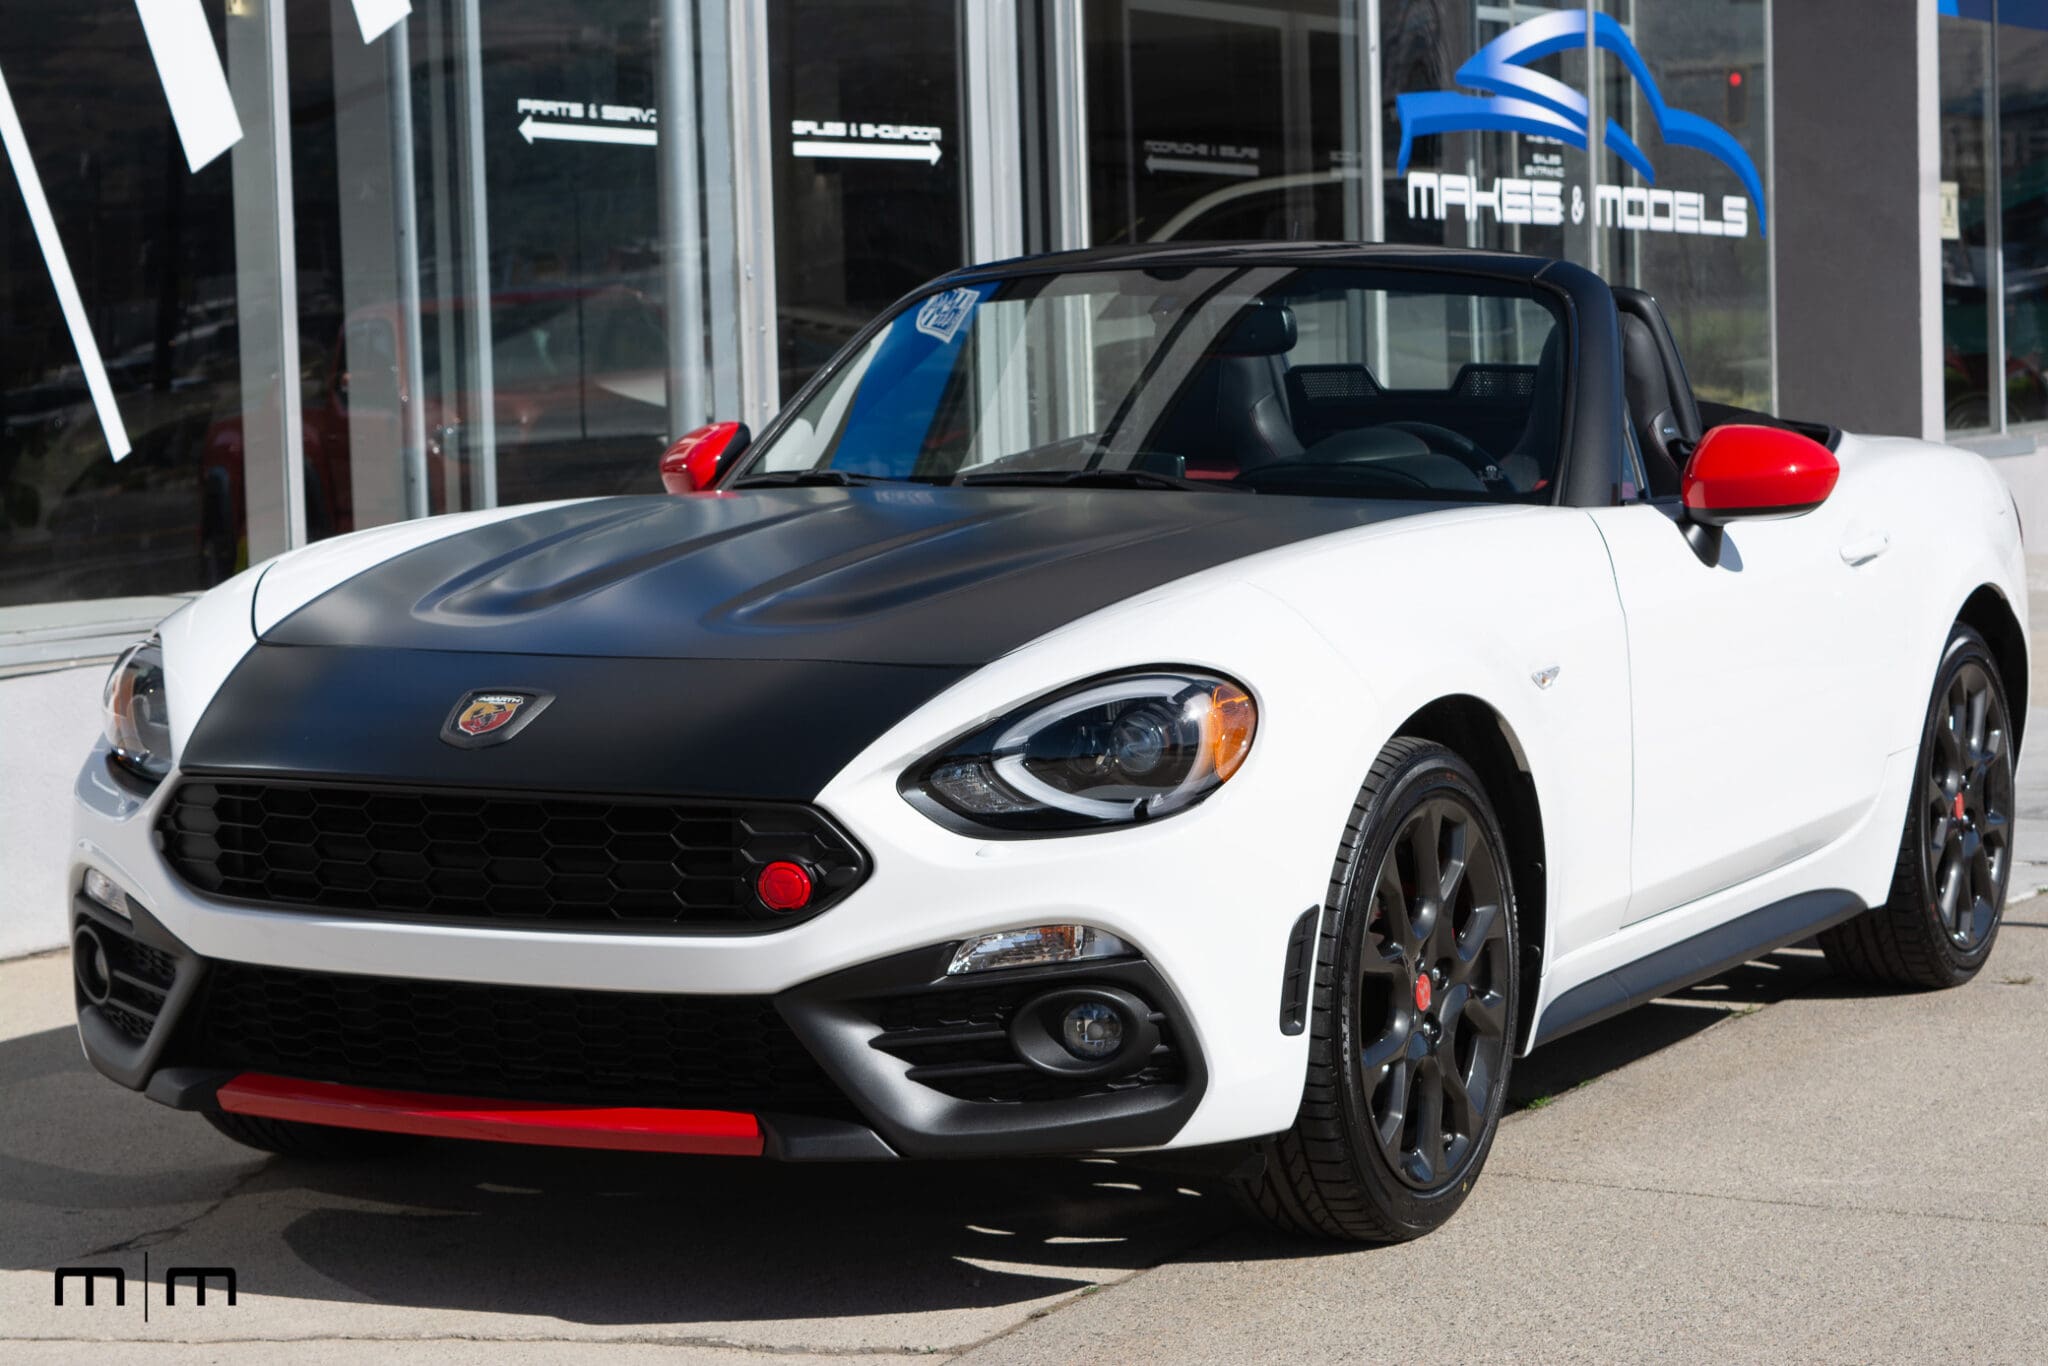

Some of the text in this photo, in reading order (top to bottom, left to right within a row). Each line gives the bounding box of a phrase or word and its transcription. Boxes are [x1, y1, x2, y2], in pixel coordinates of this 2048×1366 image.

[517, 98, 583, 118] PARTS
[1408, 172, 1748, 237] MAKES & MODELS
